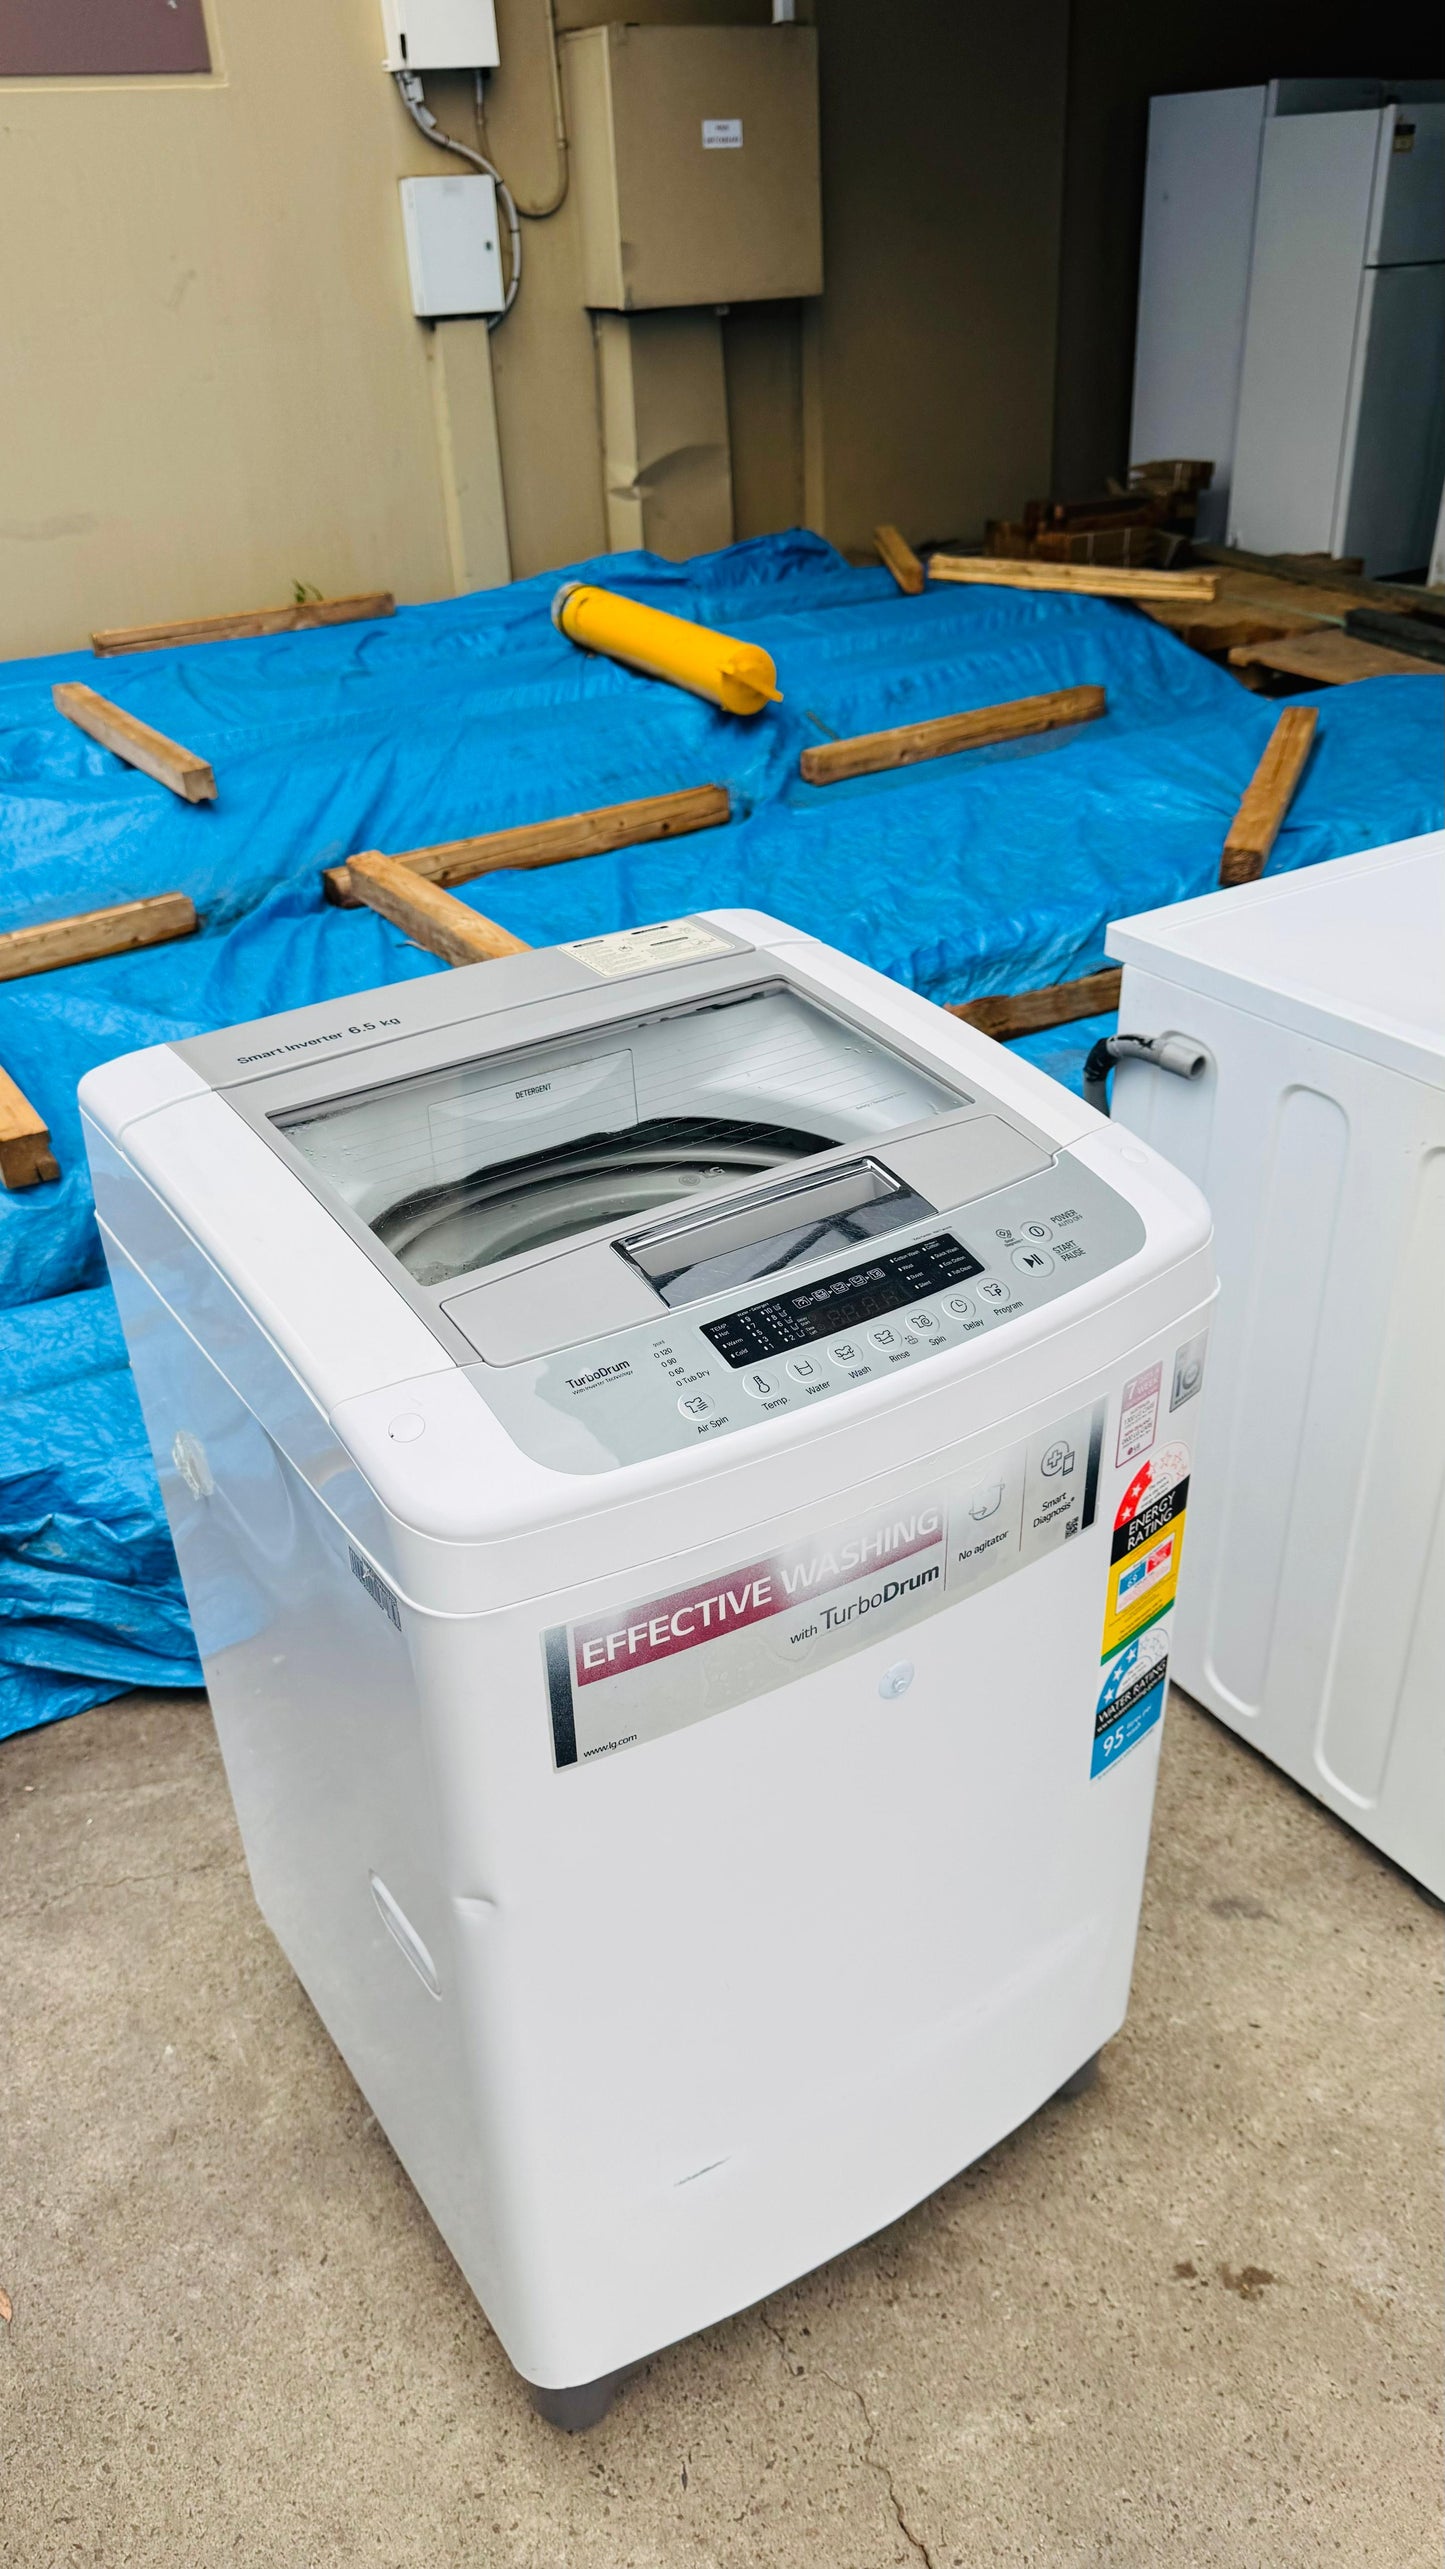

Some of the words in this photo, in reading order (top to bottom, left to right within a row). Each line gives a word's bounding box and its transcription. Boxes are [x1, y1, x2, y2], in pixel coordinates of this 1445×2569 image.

[237, 1048, 287, 1065] Smart
[285, 1032, 343, 1053] Inverter
[348, 1022, 376, 1035] 6.5
[379, 1017, 401, 1027] kg
[515, 1082, 551, 1099] DETERGENT
[1050, 1209, 1078, 1223] POWER
[1052, 1240, 1077, 1254] START
[1060, 1247, 1086, 1262] PAUSE
[763, 1307, 774, 1315] 10
[993, 1299, 1024, 1317] Program
[962, 1318, 985, 1332] Delay
[718, 1330, 730, 1338] Hot
[928, 1334, 947, 1348] Spin
[726, 1337, 744, 1348] Warm
[659, 1347, 673, 1356] 120
[735, 1348, 749, 1358] Cold
[888, 1349, 911, 1364] Rinse
[666, 1357, 677, 1366] 90
[565, 1359, 631, 1389] TurboDrum
[674, 1366, 685, 1375] 60
[681, 1375, 698, 1384] Tub
[696, 1369, 710, 1379] Dry
[847, 1364, 872, 1380] Wash
[805, 1379, 831, 1396] Water
[761, 1397, 791, 1412] Temp.
[697, 1423, 709, 1435] Air
[709, 1415, 729, 1430] Spin
[1042, 1491, 1067, 1512] Smart
[1128, 1490, 1177, 1536] ENERGY
[1127, 1507, 1174, 1551] RATING
[958, 1549, 974, 1562] No
[974, 1529, 1009, 1555] agitator
[582, 1576, 772, 1670] EFFECTIVE
[779, 1506, 939, 1595] WASHING
[790, 1624, 818, 1645] with
[820, 1565, 940, 1630] TurboDrum
[1099, 1690, 1132, 1723] WATER
[1132, 1659, 1166, 1697] RATING
[583, 1732, 638, 1758] www.lg.com
[1103, 1725, 1125, 1757] 95
